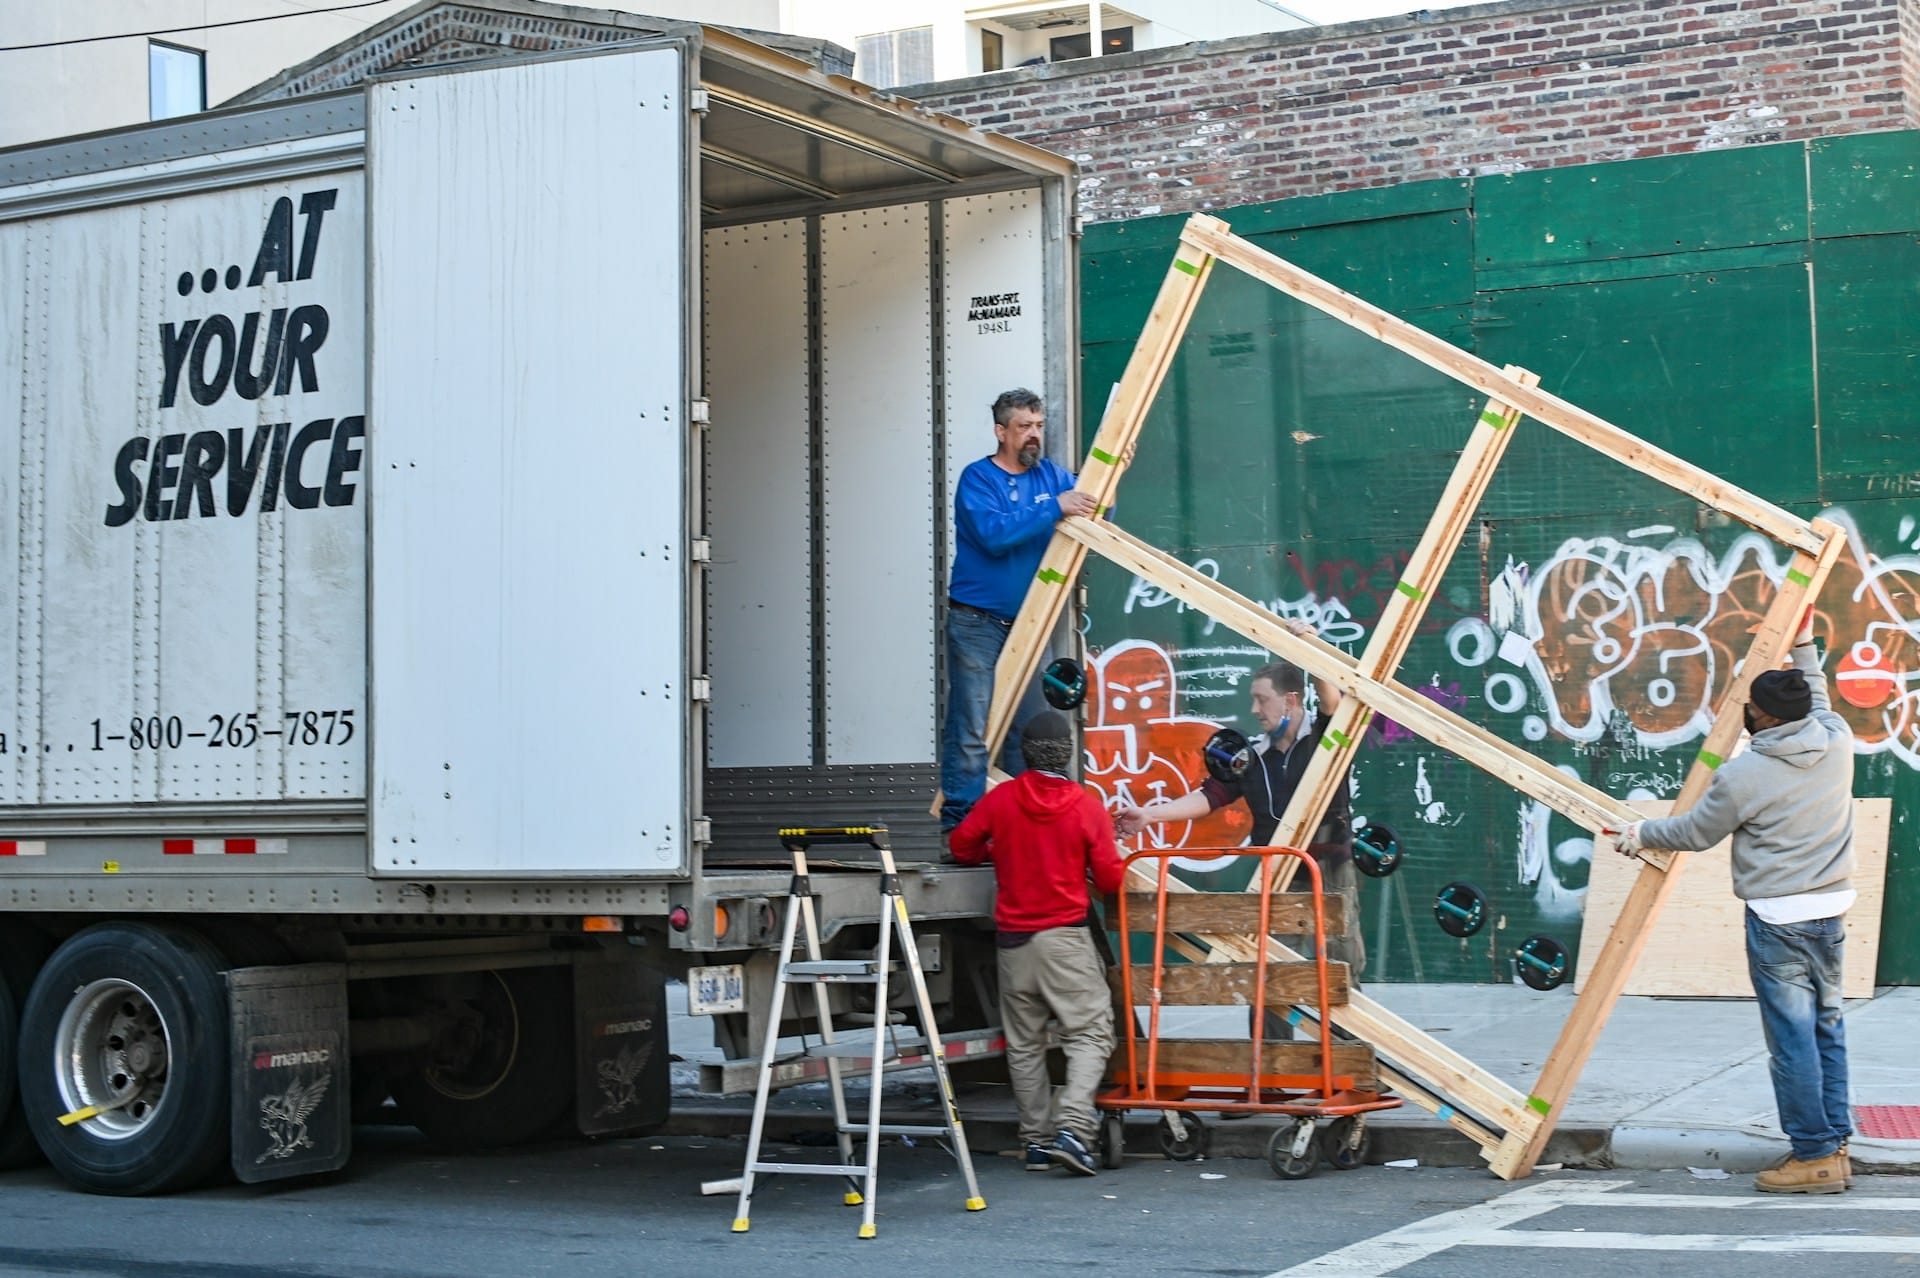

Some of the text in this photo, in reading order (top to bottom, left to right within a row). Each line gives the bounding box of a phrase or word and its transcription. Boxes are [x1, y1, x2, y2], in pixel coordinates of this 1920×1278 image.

[158, 304, 330, 408] YOUR
[104, 415, 366, 527] SERVICE
[90, 709, 355, 751] 1-800-265-7875
[270, 1048, 330, 1068] manac
